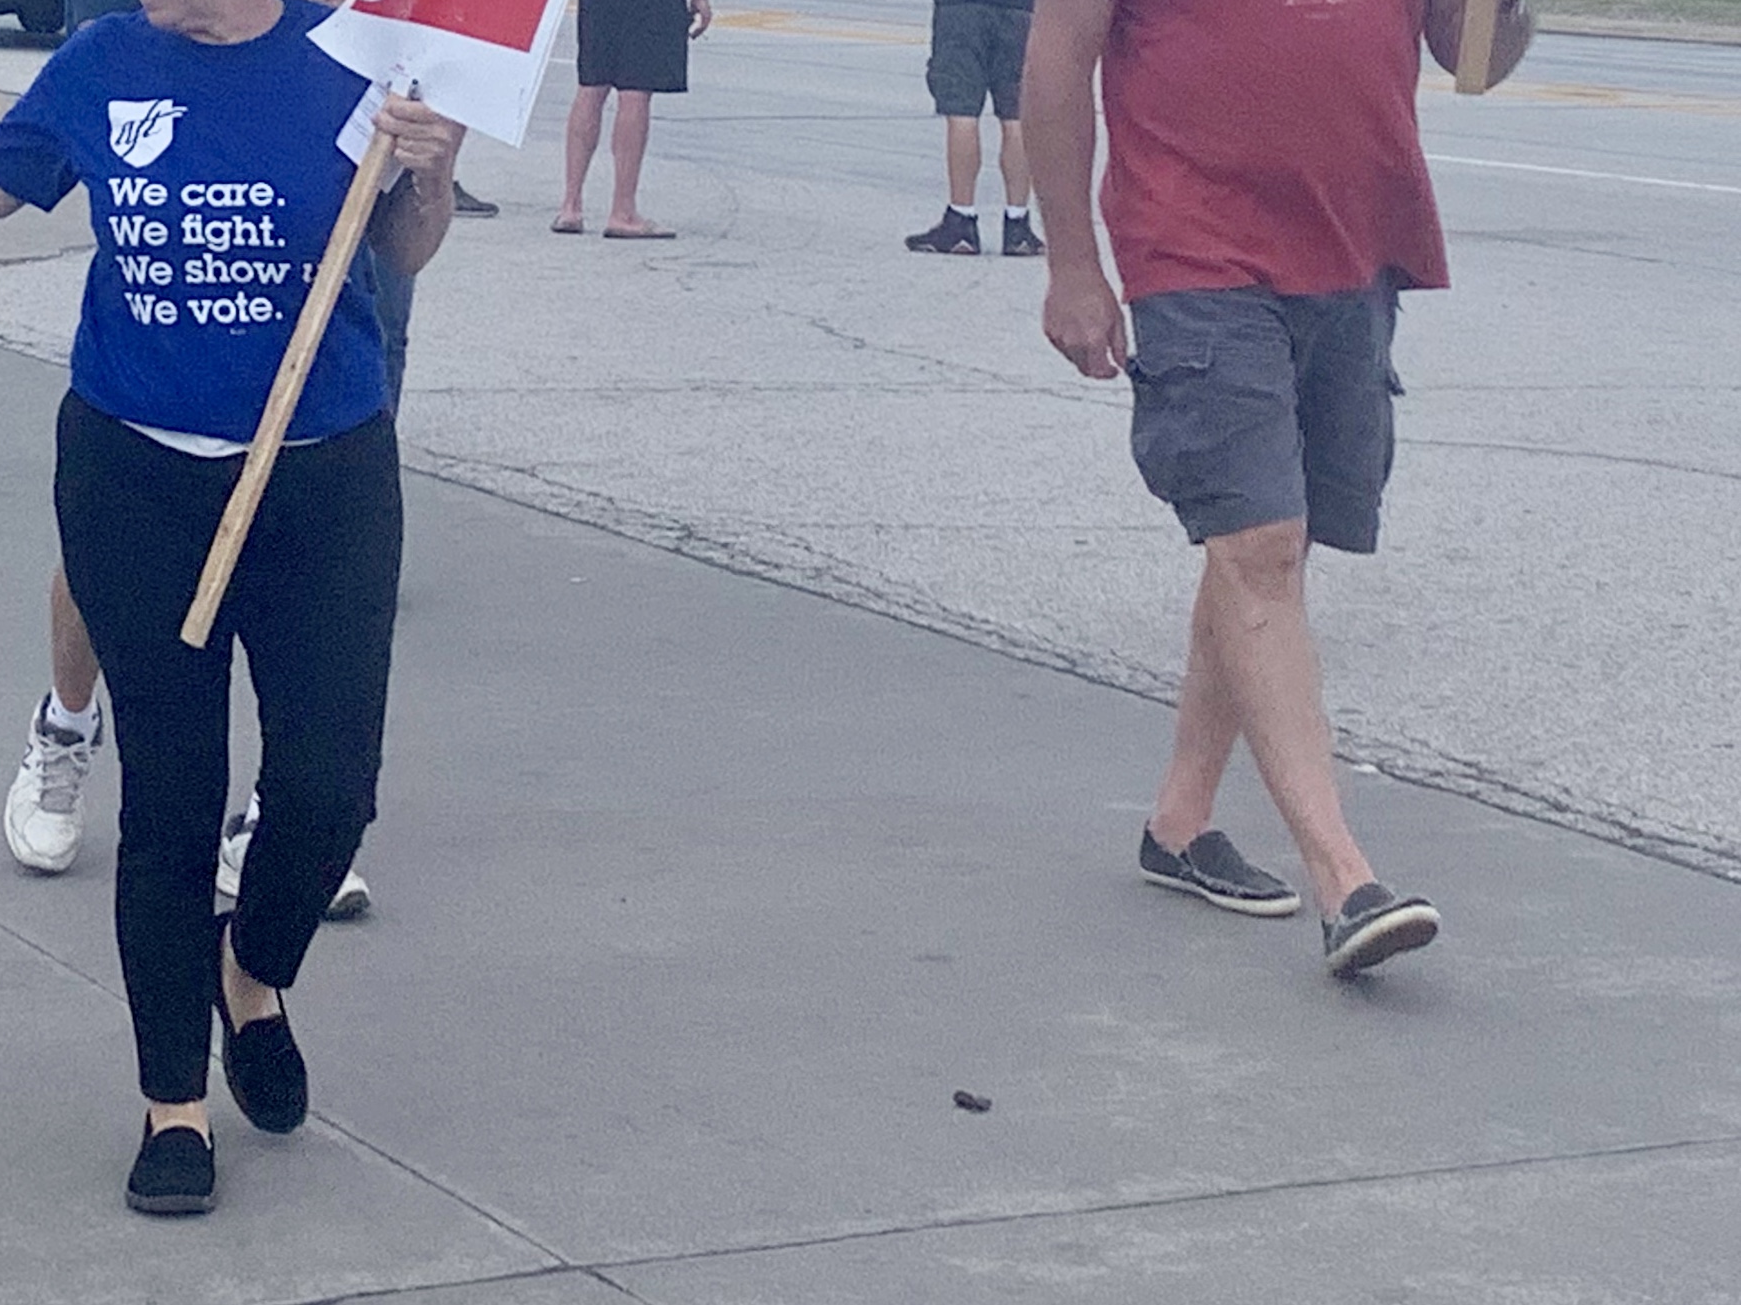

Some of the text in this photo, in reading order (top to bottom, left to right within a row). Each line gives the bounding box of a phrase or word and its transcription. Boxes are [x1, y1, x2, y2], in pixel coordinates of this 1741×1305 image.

[108, 177, 287, 207] We care.
[108, 213, 287, 253] We fight.
[116, 253, 173, 286] We
[184, 252, 291, 285] show
[124, 290, 284, 325] We vote.
